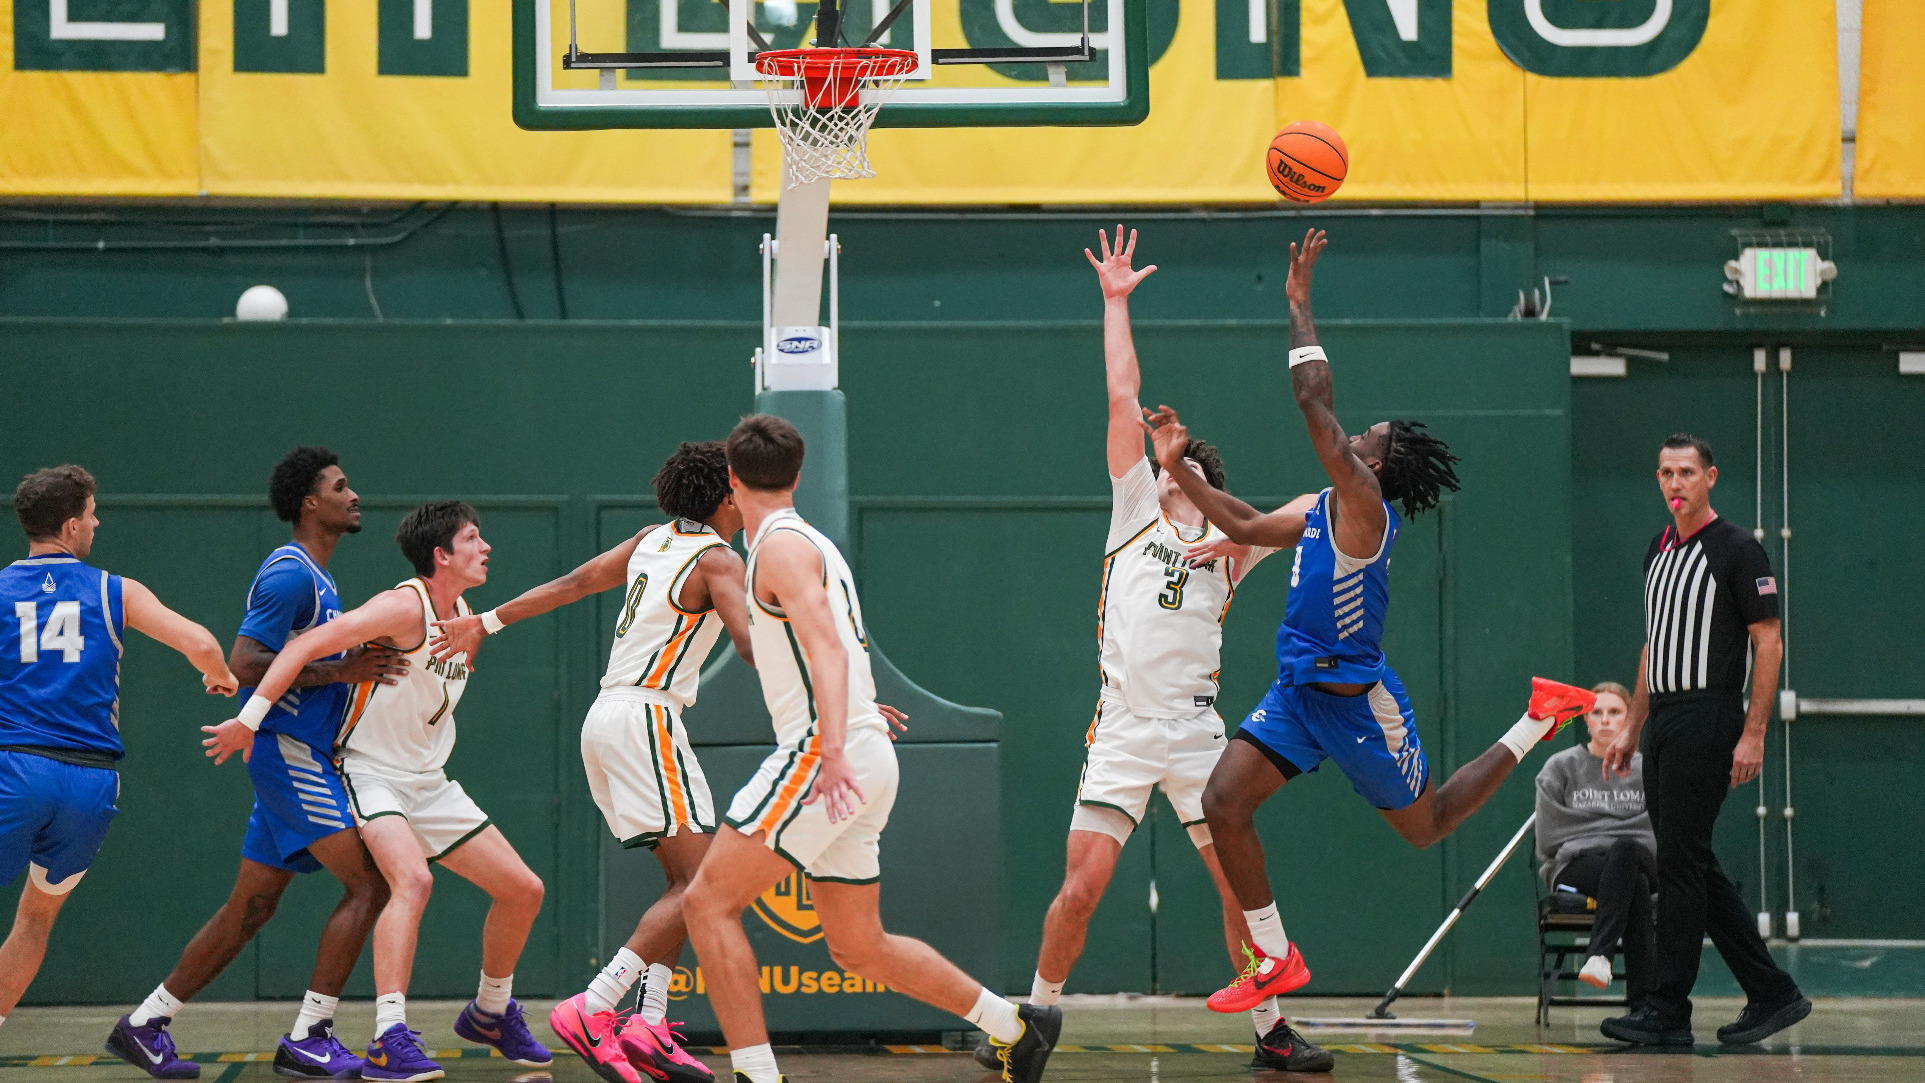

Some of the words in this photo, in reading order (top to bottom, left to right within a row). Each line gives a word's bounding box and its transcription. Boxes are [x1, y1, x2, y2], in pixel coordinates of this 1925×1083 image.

[1277, 159, 1326, 193] Wilson
[1757, 250, 1808, 291] EXIT
[1158, 566, 1189, 610] 3
[15, 601, 84, 663] 14
[1573, 788, 1610, 802] POINT
